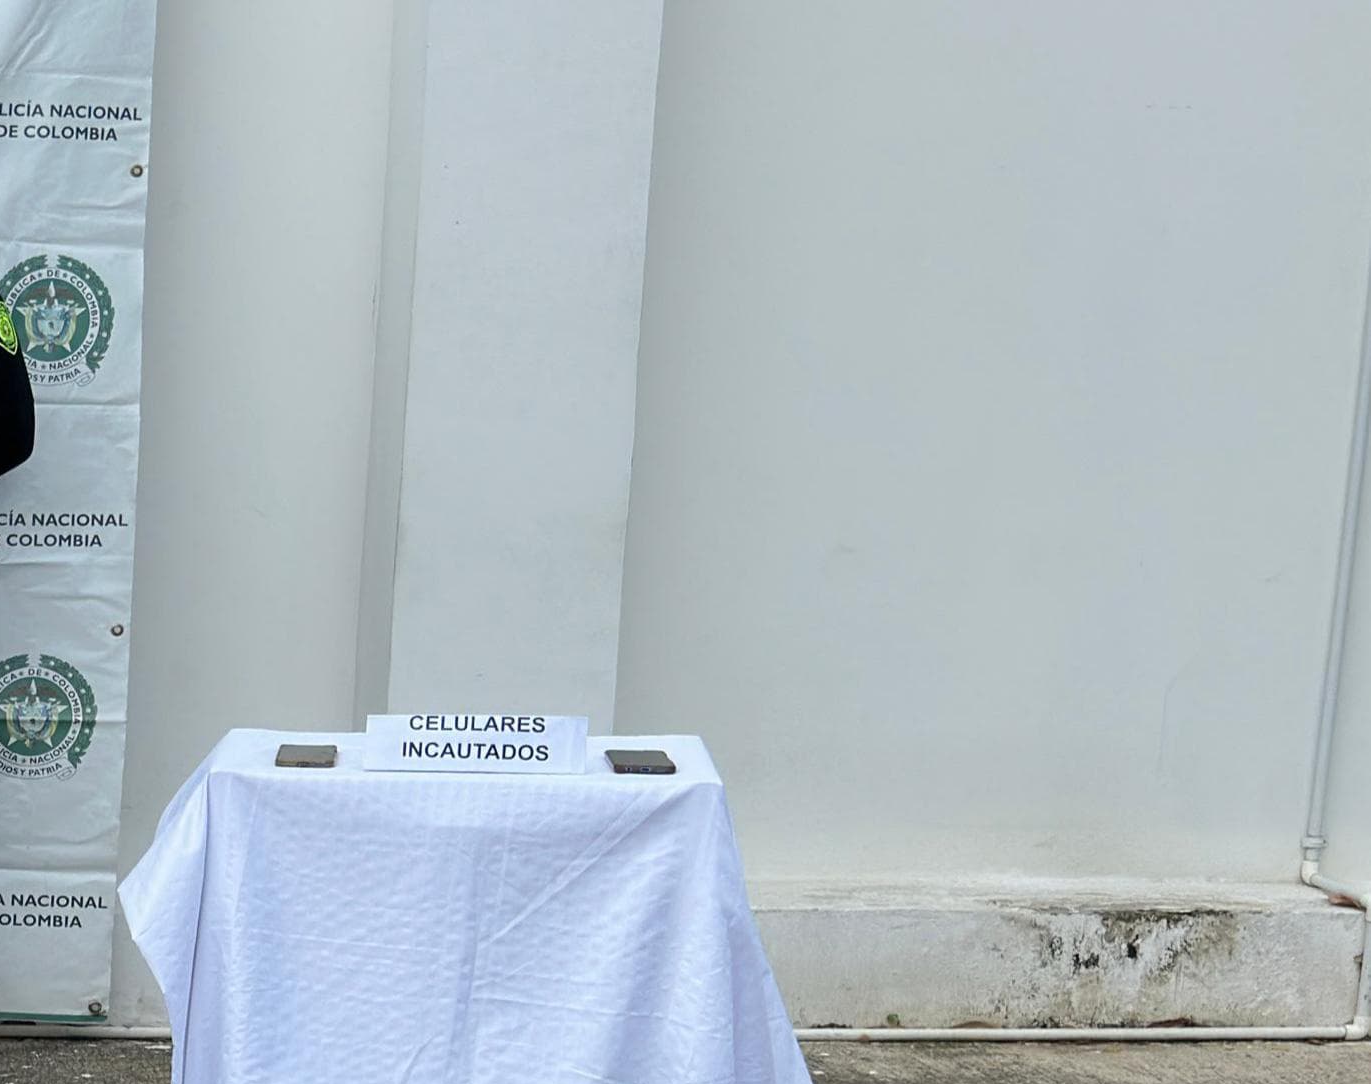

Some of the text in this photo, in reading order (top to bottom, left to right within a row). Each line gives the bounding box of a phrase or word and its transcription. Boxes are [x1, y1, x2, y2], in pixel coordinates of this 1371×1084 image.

[50, 105, 142, 121] NACIONAL
[24, 126, 117, 141] COLOMBIA
[32, 513, 128, 527] NACIONAL
[6, 534, 103, 547] COLOMBIA
[409, 715, 546, 733] CELULARES
[402, 742, 549, 761] INCAUTADOS
[11, 894, 108, 909] NACIONAL
